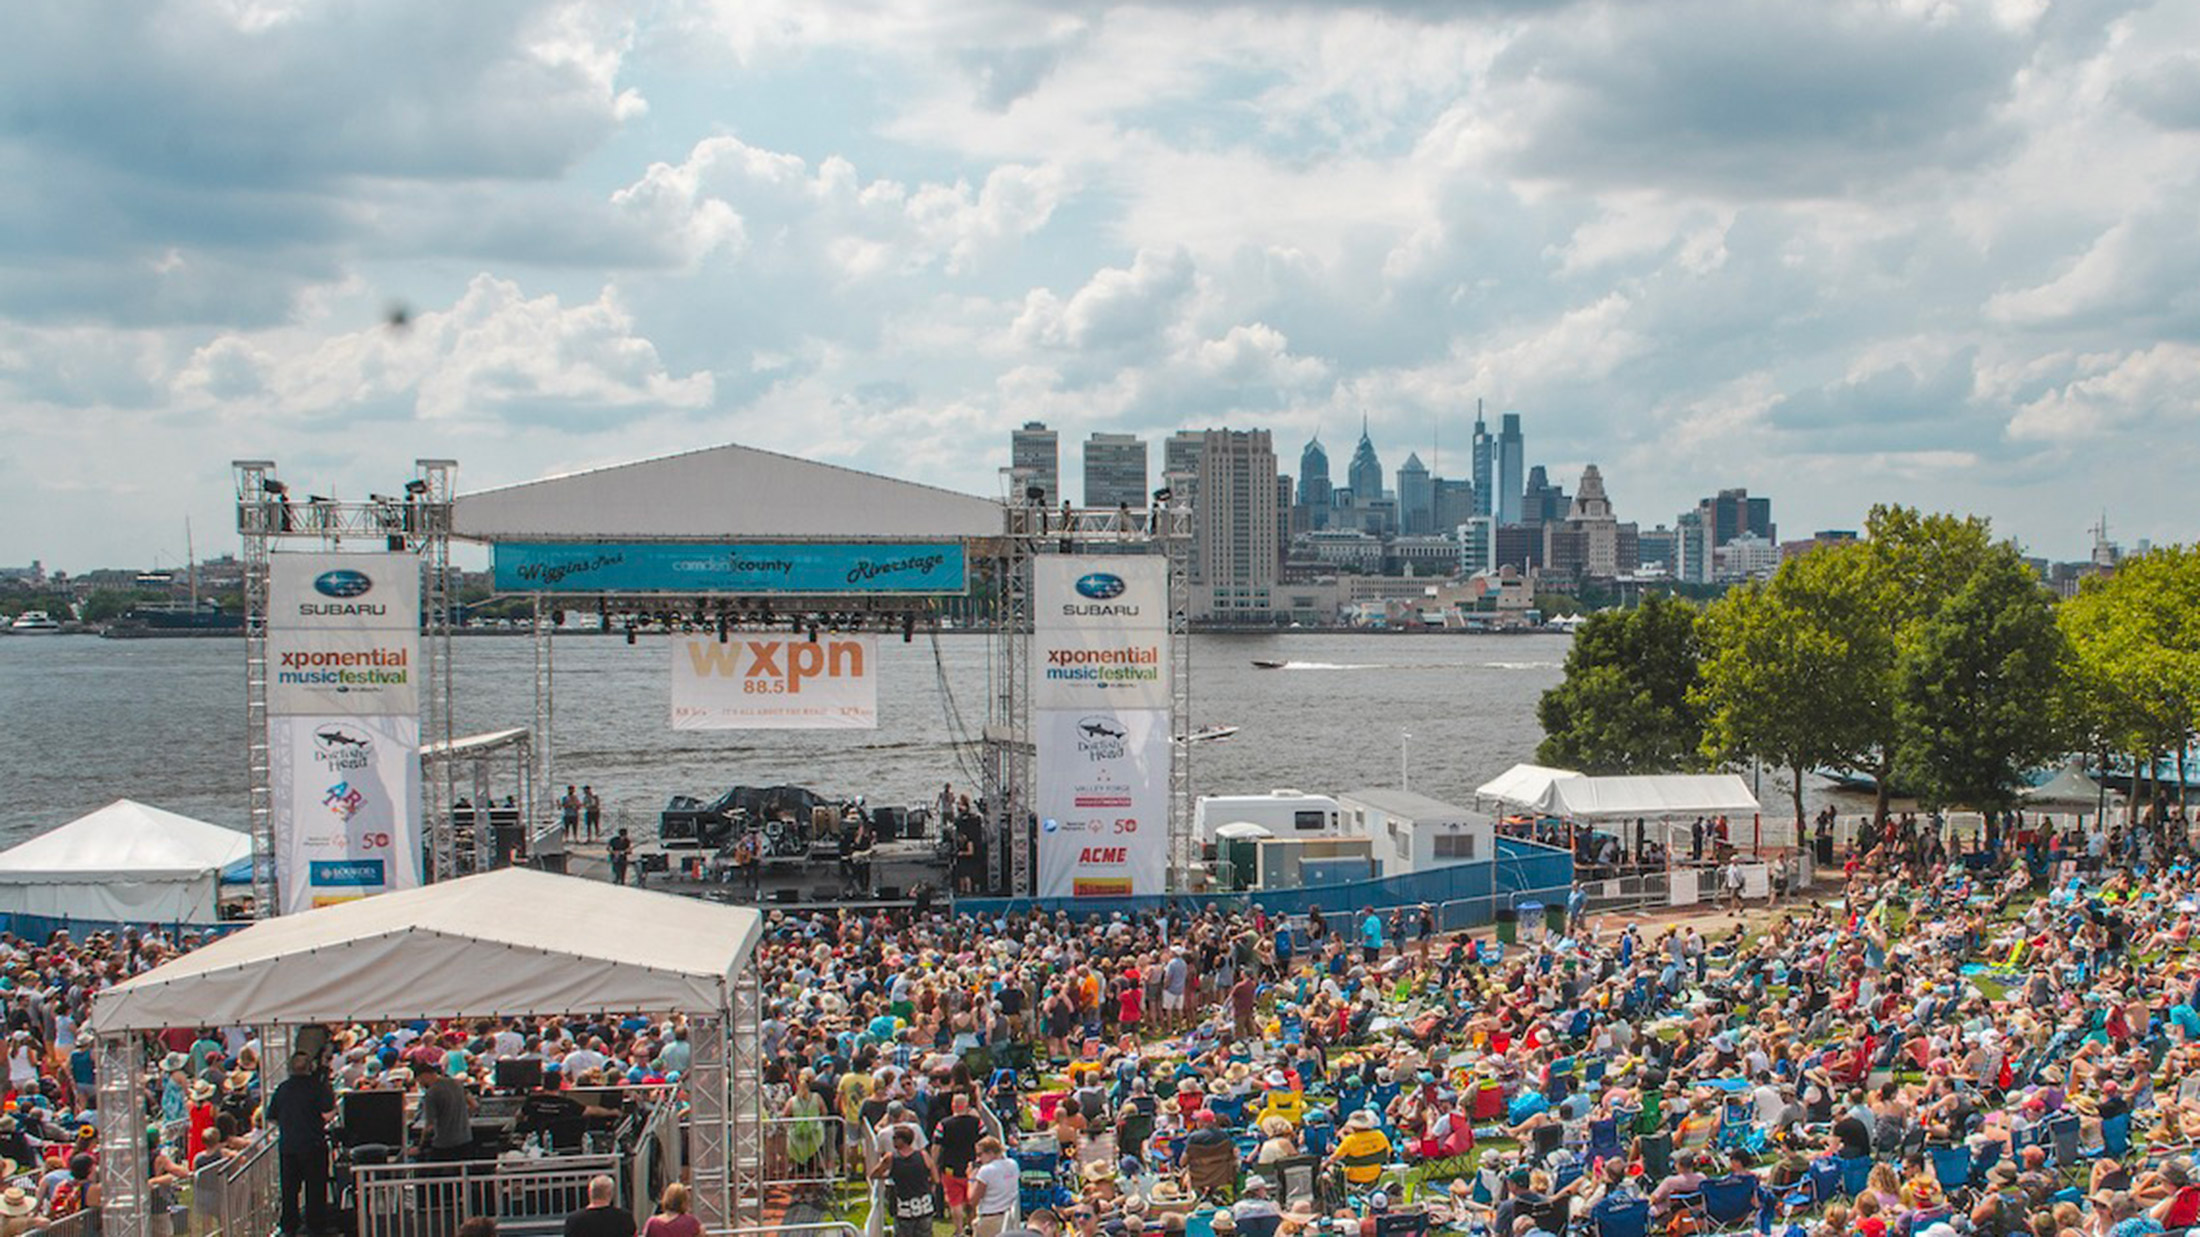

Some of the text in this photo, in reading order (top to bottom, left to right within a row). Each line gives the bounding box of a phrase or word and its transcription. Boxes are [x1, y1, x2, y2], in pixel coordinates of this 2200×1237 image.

[517, 557, 589, 584] Wiggins
[672, 555, 792, 574] camden county
[847, 554, 944, 584] Riverstage
[299, 604, 386, 616] SUBARU
[1063, 604, 1139, 616] SUBARU
[281, 648, 407, 669] xponential
[1048, 647, 1158, 666] xponential
[687, 641, 863, 693] wxpn
[1047, 666, 1158, 680] musicfestival
[279, 668, 407, 684] musicfestival
[743, 679, 785, 694] 88.5
[329, 757, 367, 772] Head
[1113, 819, 1137, 835] 50
[362, 832, 389, 849] 50
[1079, 847, 1127, 863] ACME
